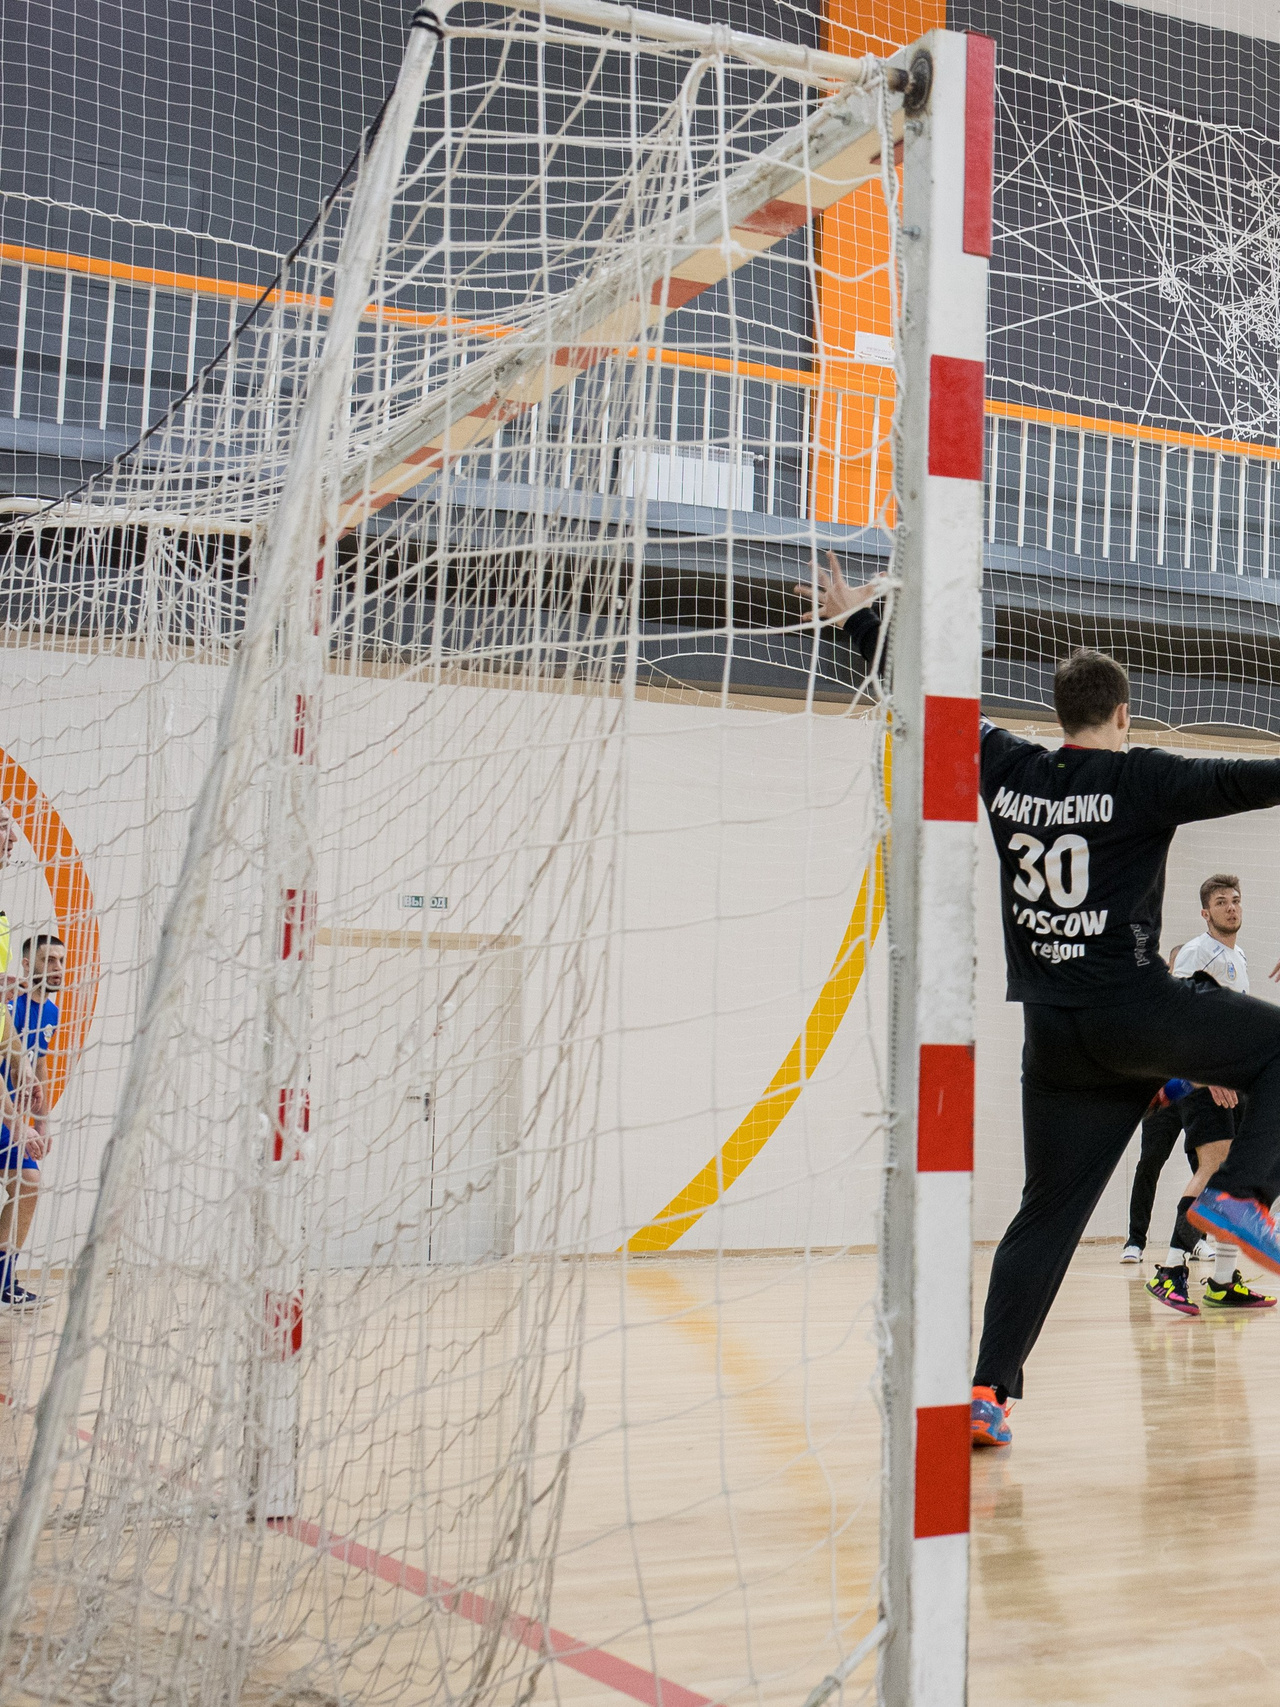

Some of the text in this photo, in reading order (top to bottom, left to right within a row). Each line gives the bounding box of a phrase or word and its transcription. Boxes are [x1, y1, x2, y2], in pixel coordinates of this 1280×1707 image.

[1008, 833, 1090, 908] 30
[403, 896, 447, 908] ВЫОД
[1013, 902, 1108, 938] OSCOW
